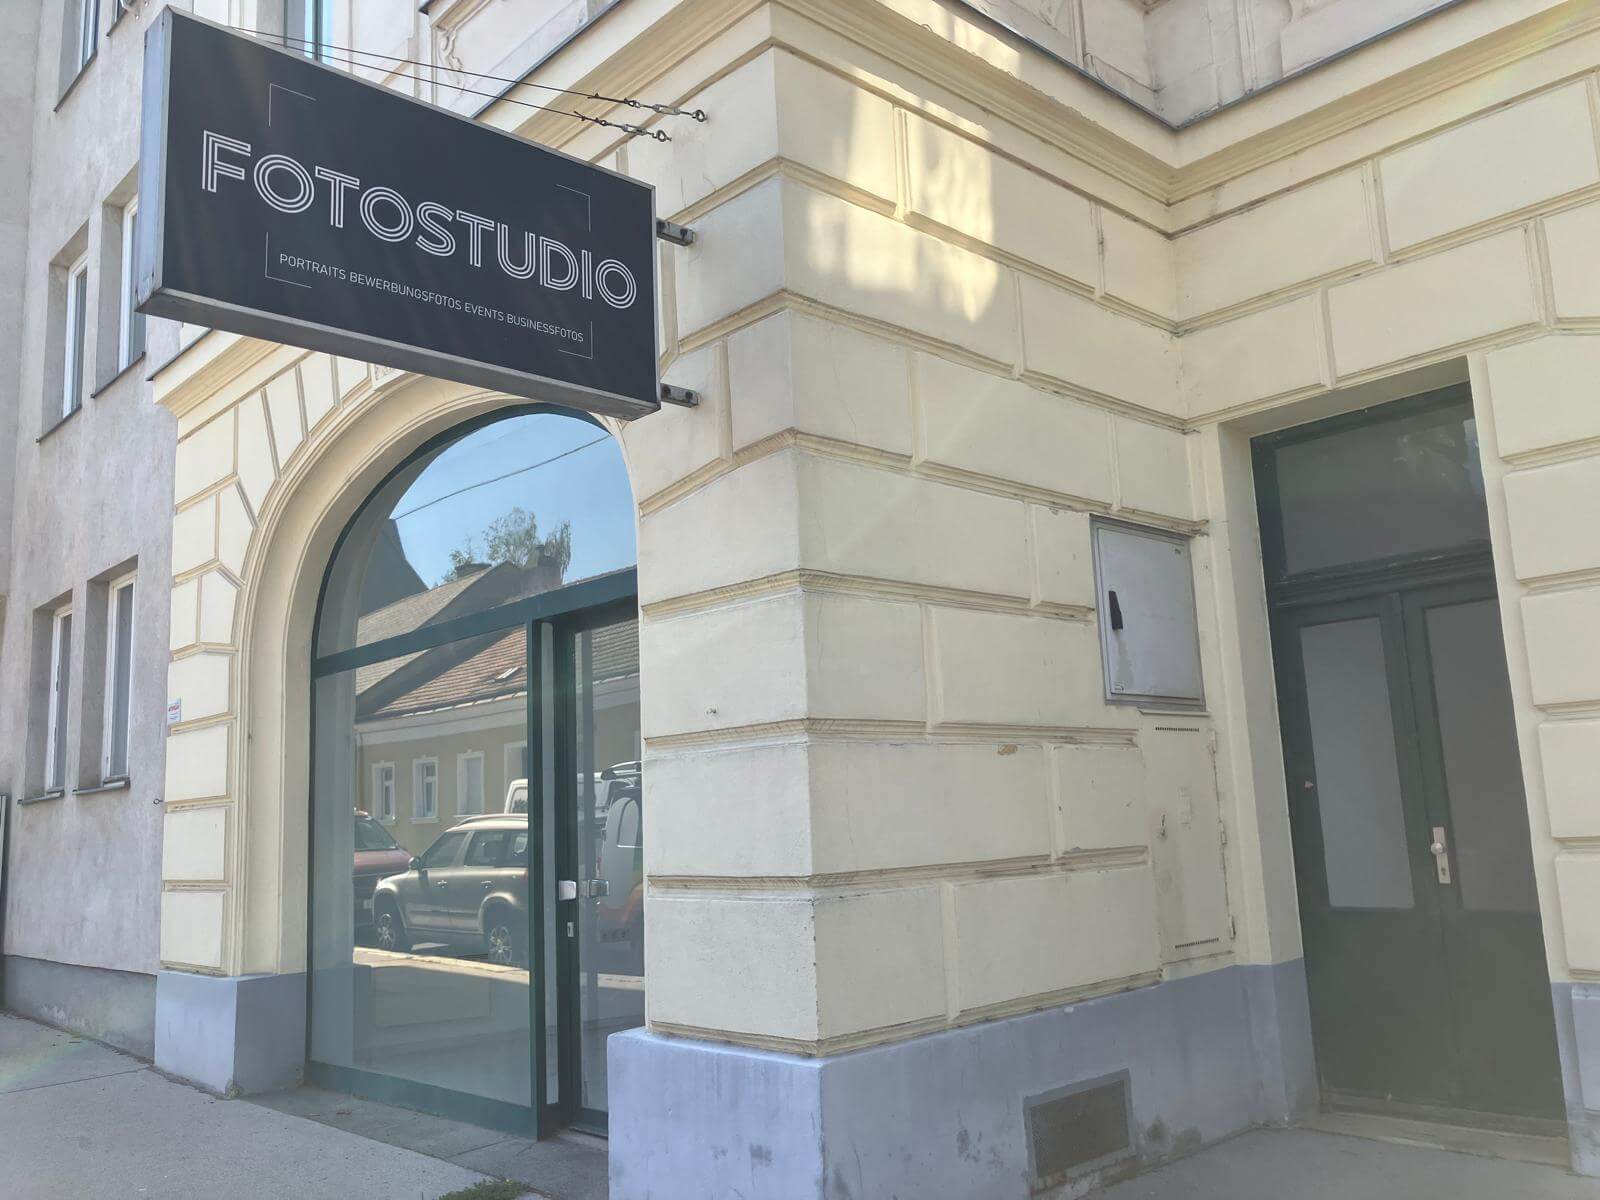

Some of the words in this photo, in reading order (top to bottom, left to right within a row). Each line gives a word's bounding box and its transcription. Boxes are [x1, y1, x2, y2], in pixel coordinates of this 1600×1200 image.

[202, 130, 637, 309] FOTOSTUDIO
[279, 253, 346, 280] PORTRAITS
[349, 271, 462, 310] BEWERBUNGSFOTOS
[464, 302, 504, 321] EVENTS
[506, 313, 584, 342] BUSINESSFOTOS
